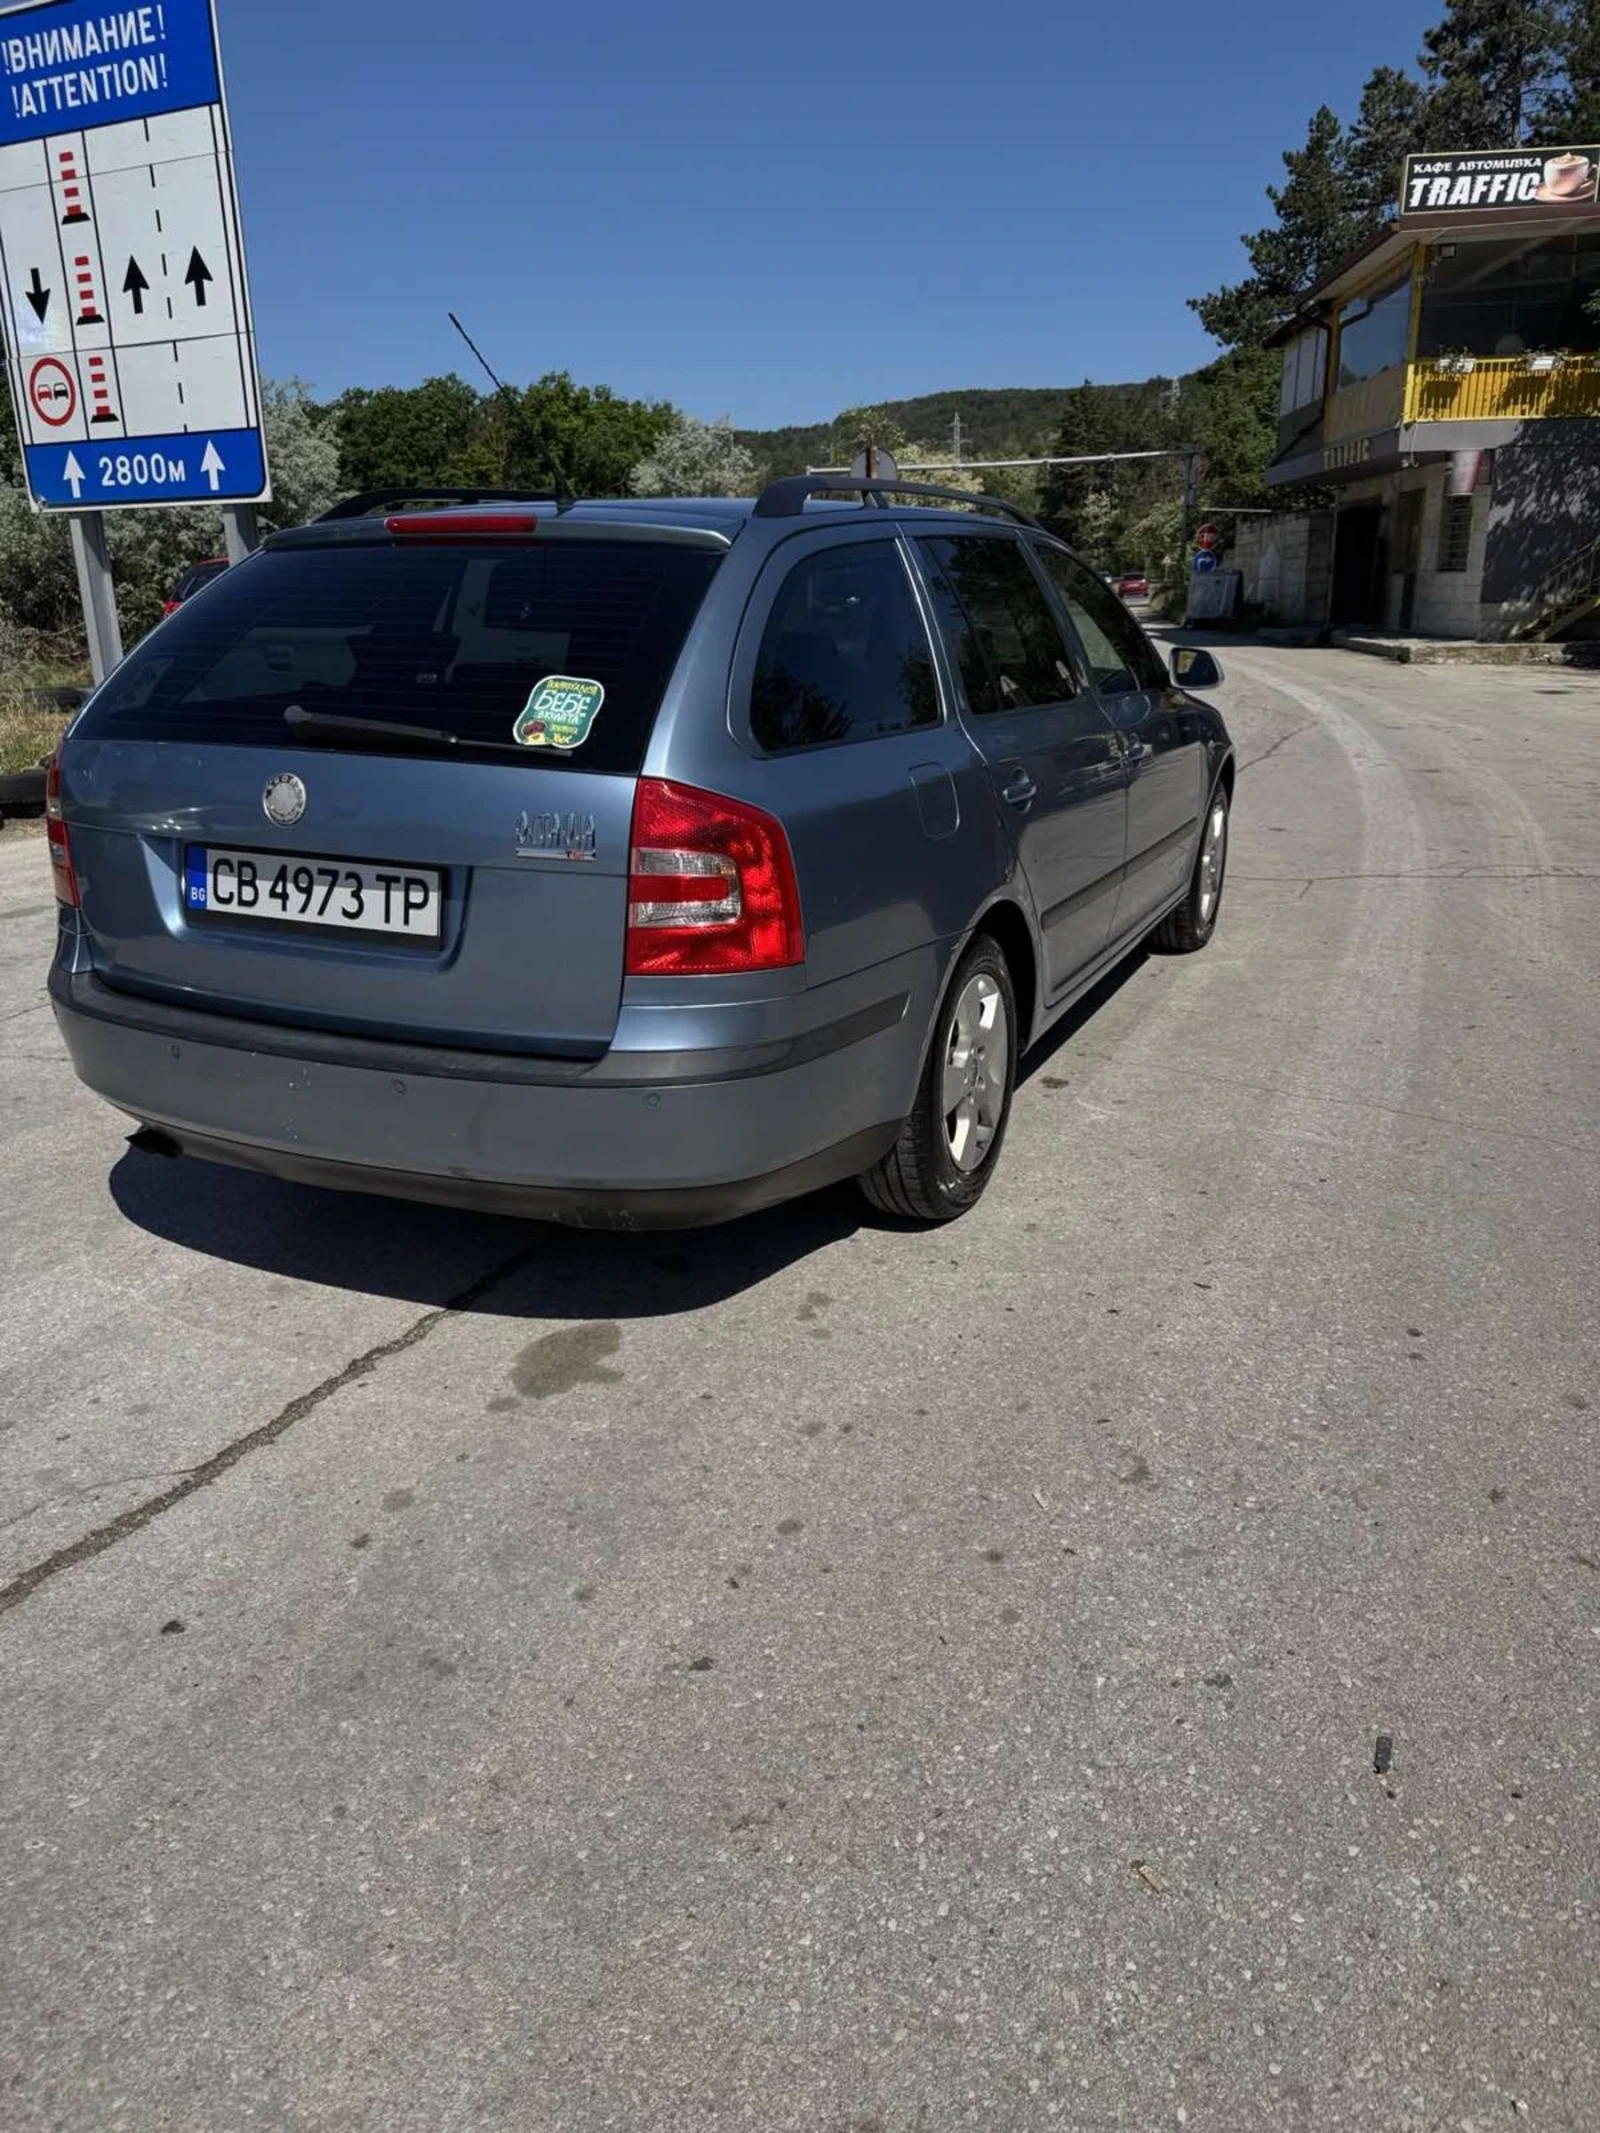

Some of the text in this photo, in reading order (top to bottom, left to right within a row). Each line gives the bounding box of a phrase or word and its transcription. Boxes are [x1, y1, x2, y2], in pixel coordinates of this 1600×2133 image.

[1, 4, 166, 75] !ВНИМАНИЕ!
[11, 53, 168, 118] !ATTENTION!
[1409, 173, 1541, 207] TRAFFIC
[1413, 161, 1452, 174] КАФЕ
[191, 886, 206, 902] BG
[212, 857, 430, 926] CB 4973 TP
